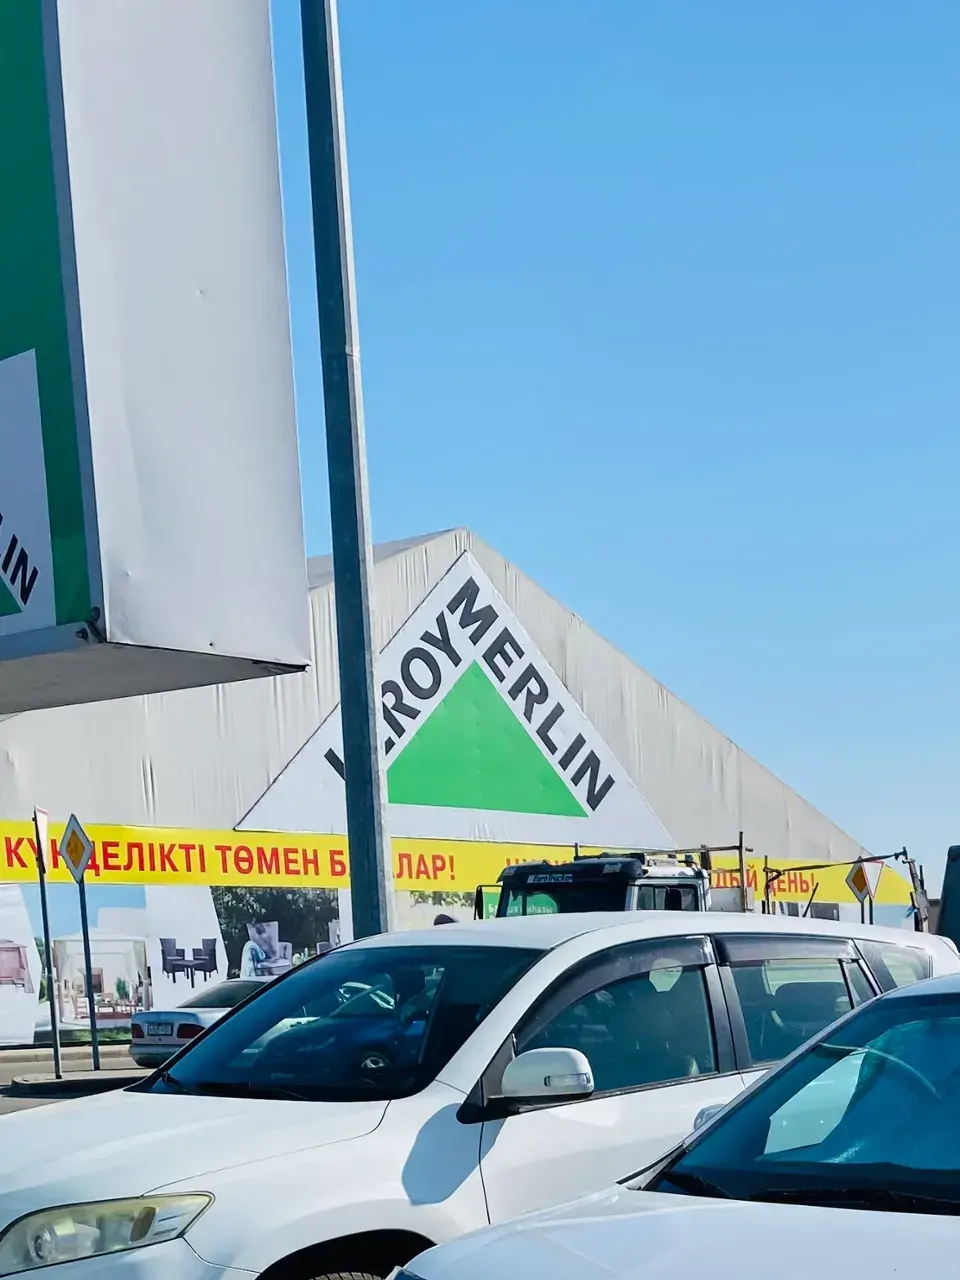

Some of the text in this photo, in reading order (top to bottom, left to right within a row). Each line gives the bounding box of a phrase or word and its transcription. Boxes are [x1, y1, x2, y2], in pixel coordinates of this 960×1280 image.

[446, 575, 616, 812] MERLIN
[215, 844, 319, 876] ТӨМЕН
[329, 849, 455, 881] БЛАР!
